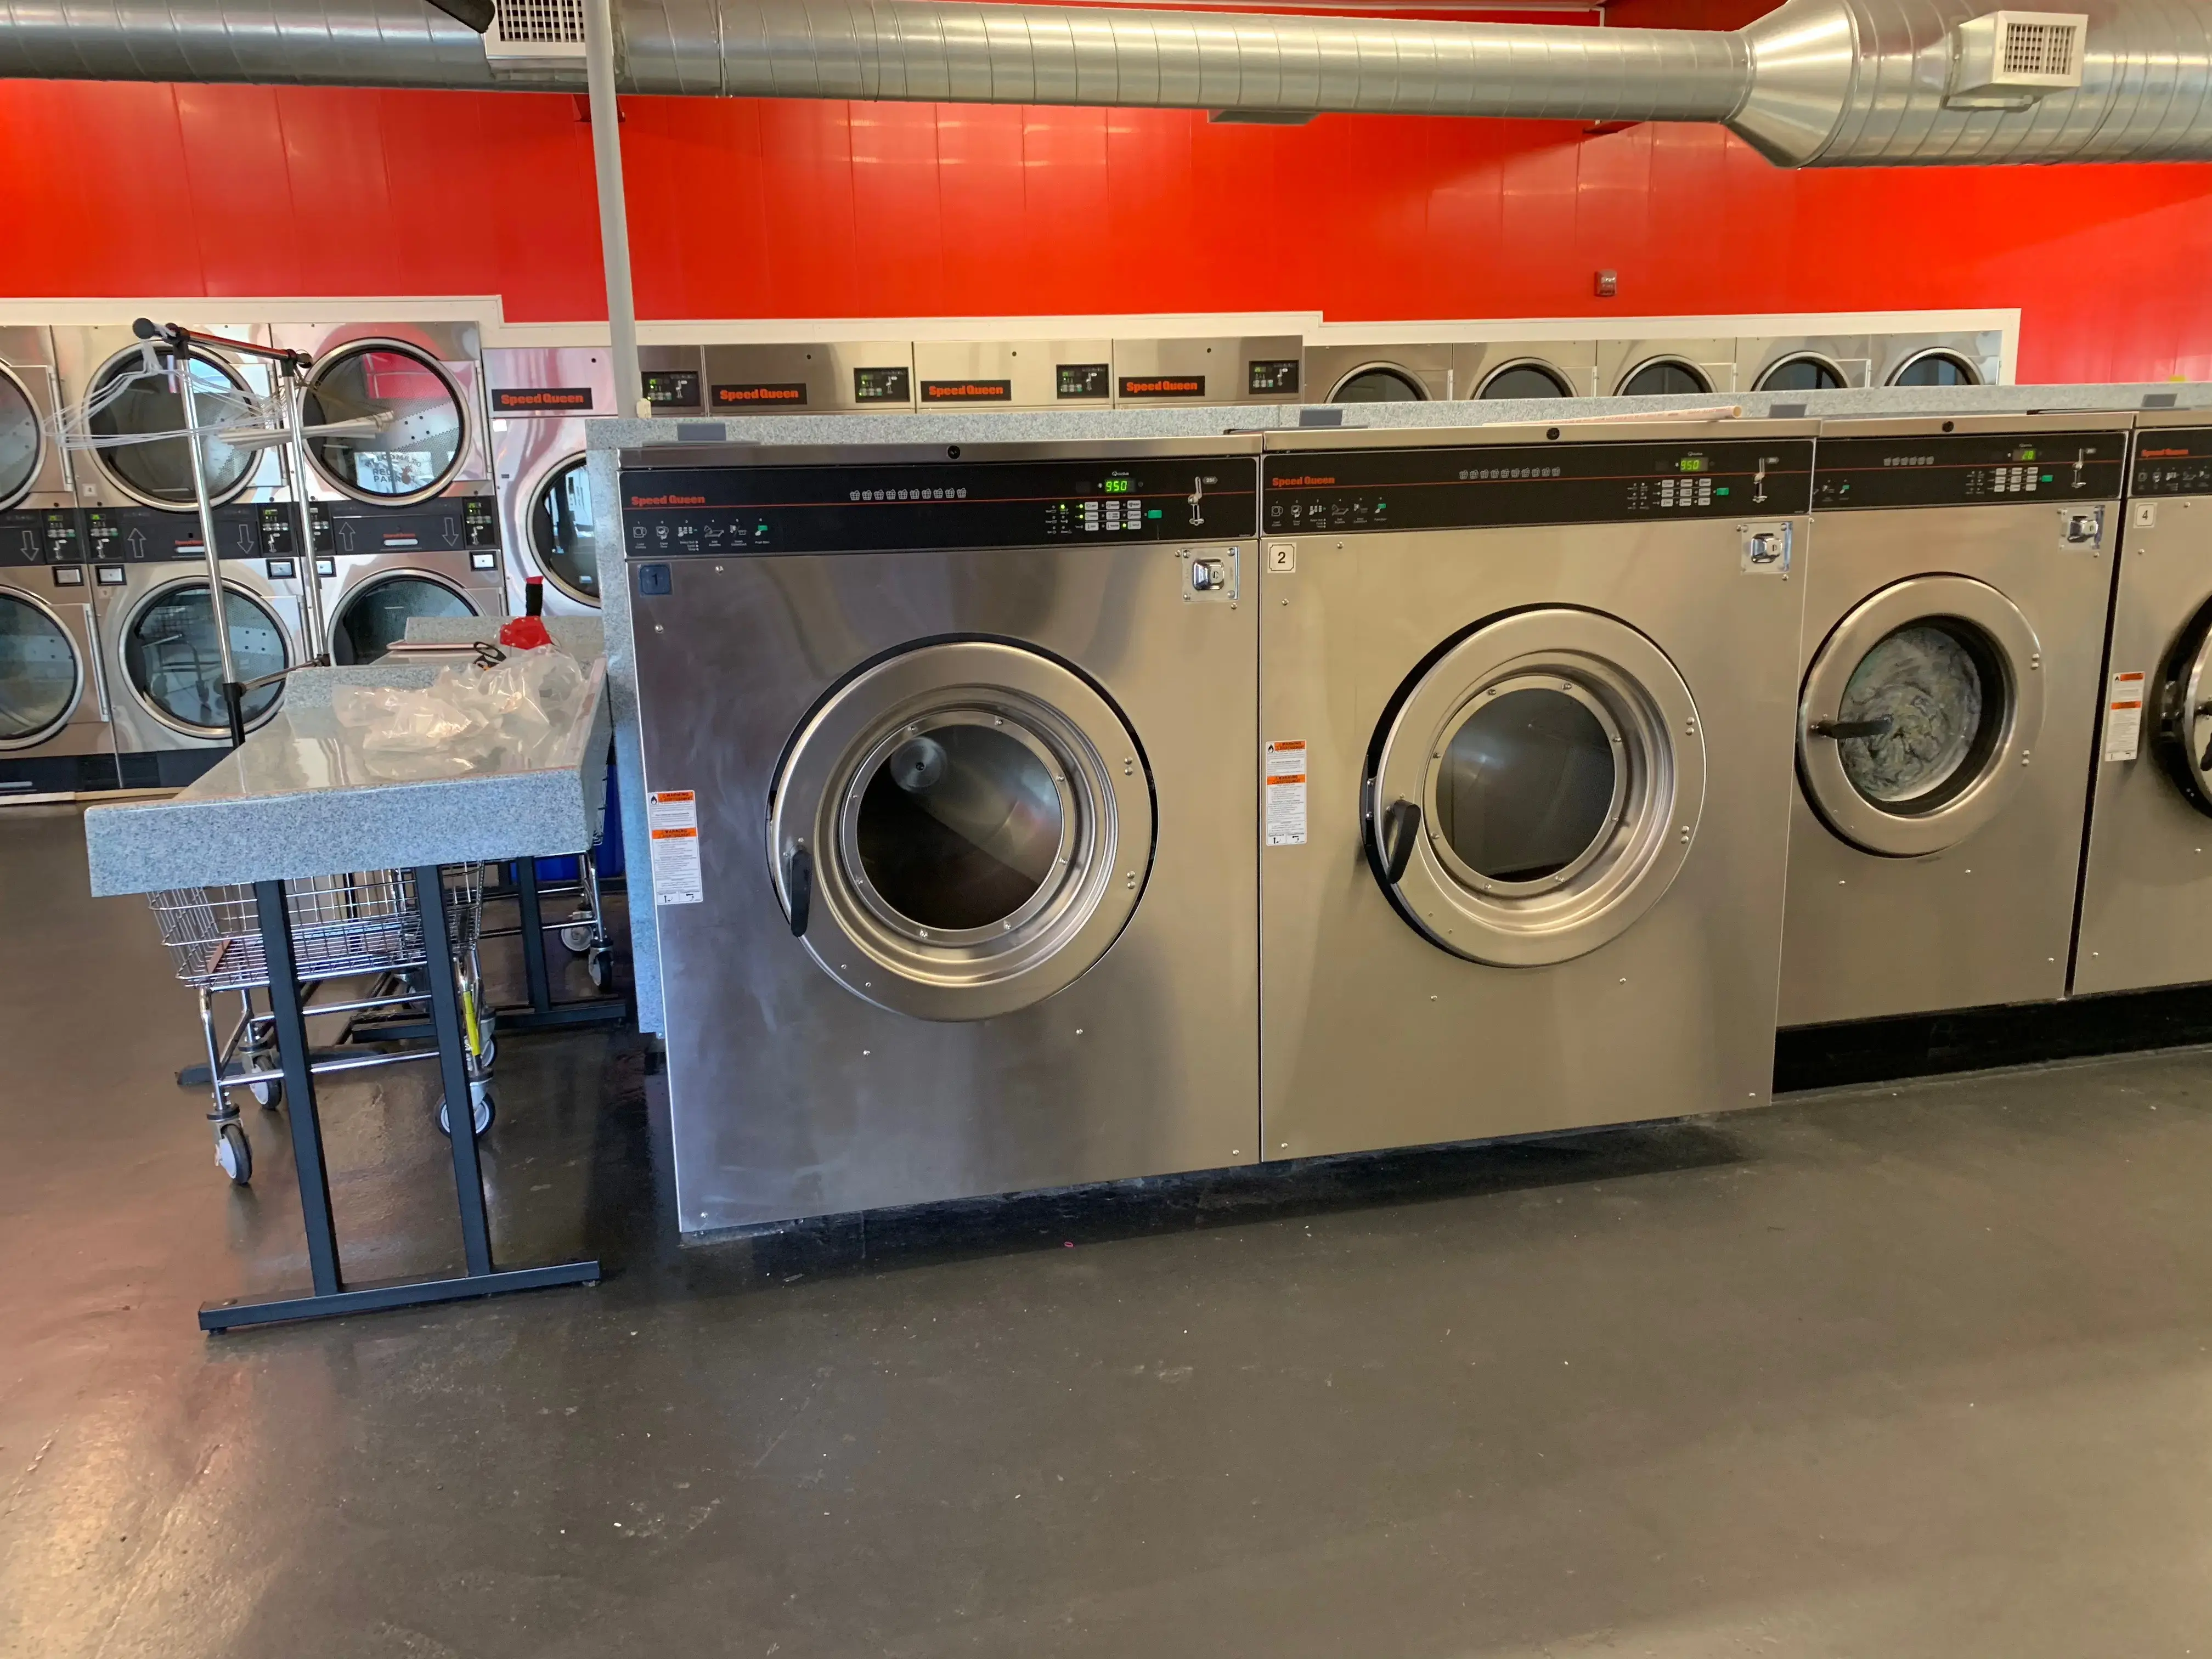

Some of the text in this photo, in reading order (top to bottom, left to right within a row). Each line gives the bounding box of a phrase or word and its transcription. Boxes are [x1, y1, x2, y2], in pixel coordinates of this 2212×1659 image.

[929, 385, 1003, 397] Speed Queen
[1126, 381, 1198, 393] Speed Queen
[501, 393, 584, 406] Speed Queen
[720, 388, 799, 402] Speed Queen
[1680, 460, 1700, 470] 950
[1105, 481, 1127, 492] 950
[1272, 477, 1303, 487] Speed
[631, 495, 706, 507] Speed Queen
[2142, 510, 2148, 520] 4
[1278, 551, 1286, 564] 2
[652, 573, 658, 586] 1
